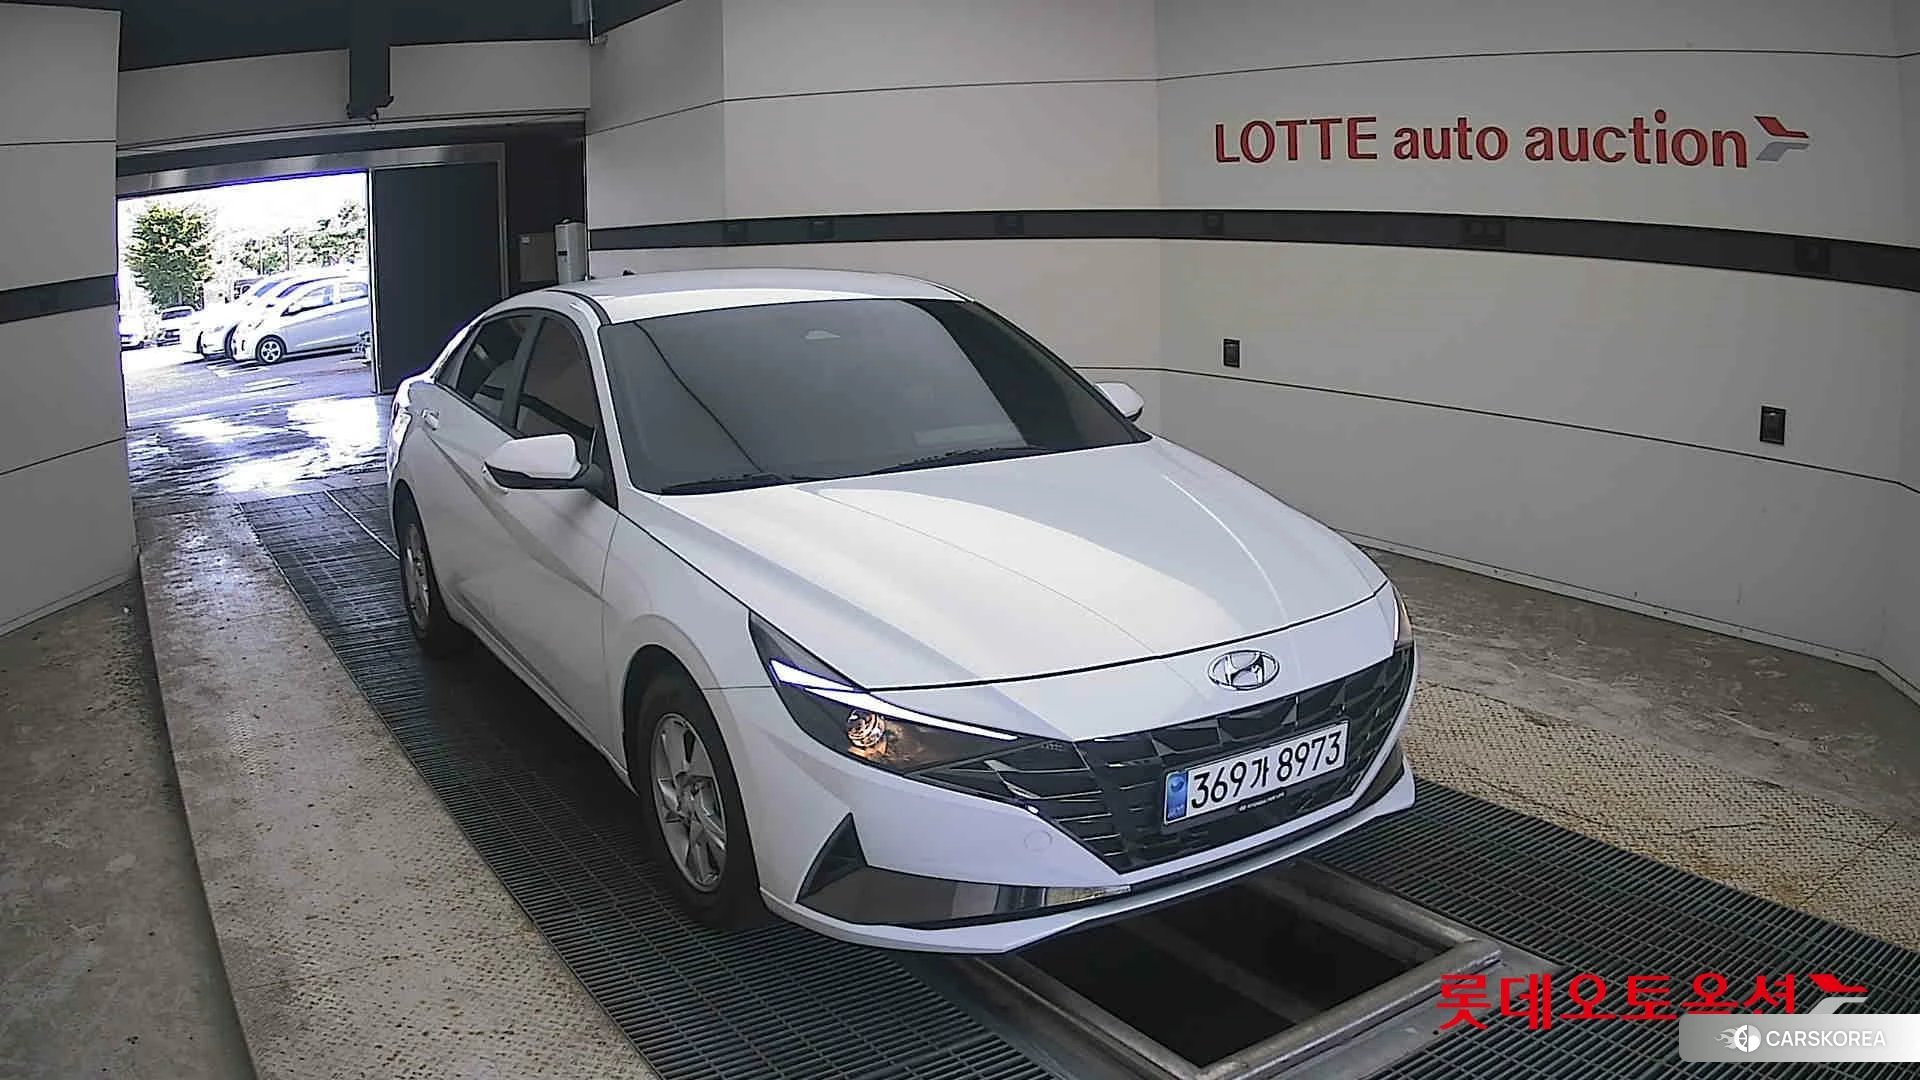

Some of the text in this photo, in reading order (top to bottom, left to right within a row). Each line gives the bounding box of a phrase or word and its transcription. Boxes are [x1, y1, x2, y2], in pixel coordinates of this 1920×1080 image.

[1215, 109, 1749, 169] LOTTE auto auction
[1276, 731, 1342, 782] 8973
